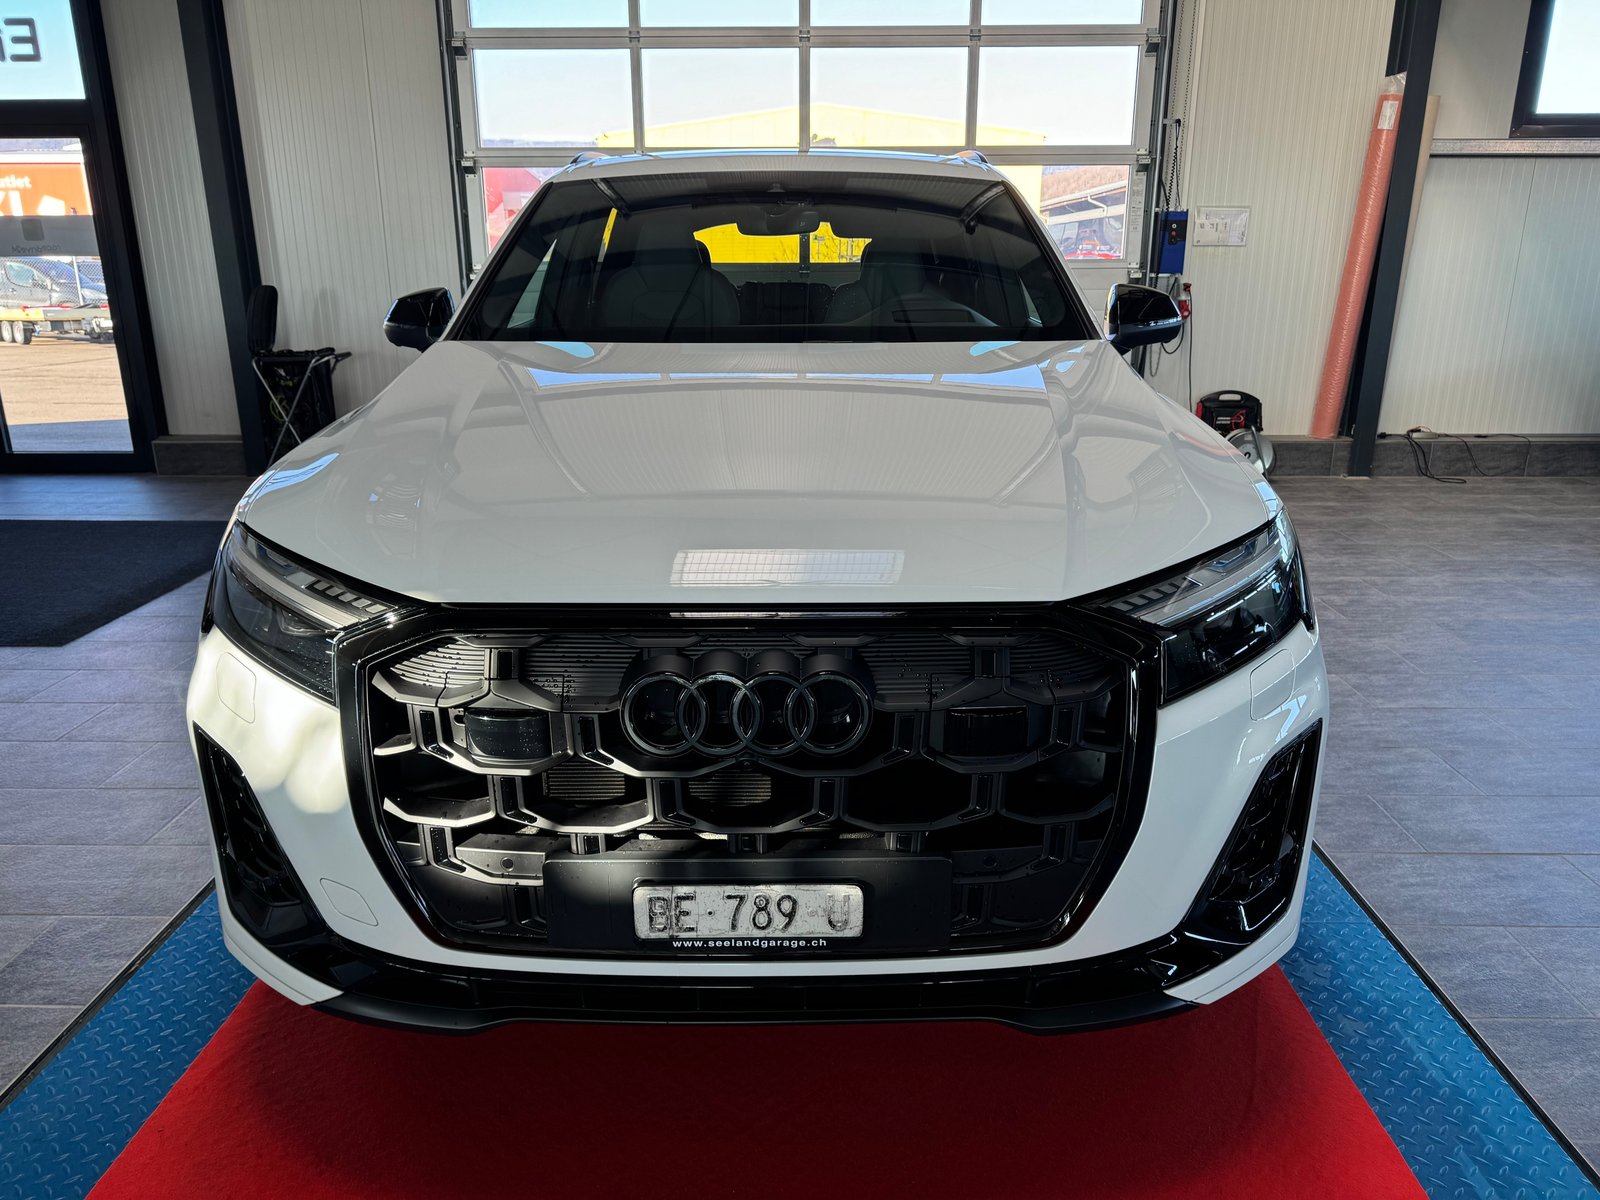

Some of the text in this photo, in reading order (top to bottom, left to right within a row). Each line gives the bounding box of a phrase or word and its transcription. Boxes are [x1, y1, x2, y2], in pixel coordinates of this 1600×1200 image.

[648, 894, 850, 933] BE 789 U
[672, 938, 827, 949] www.seelandgarage.ch
